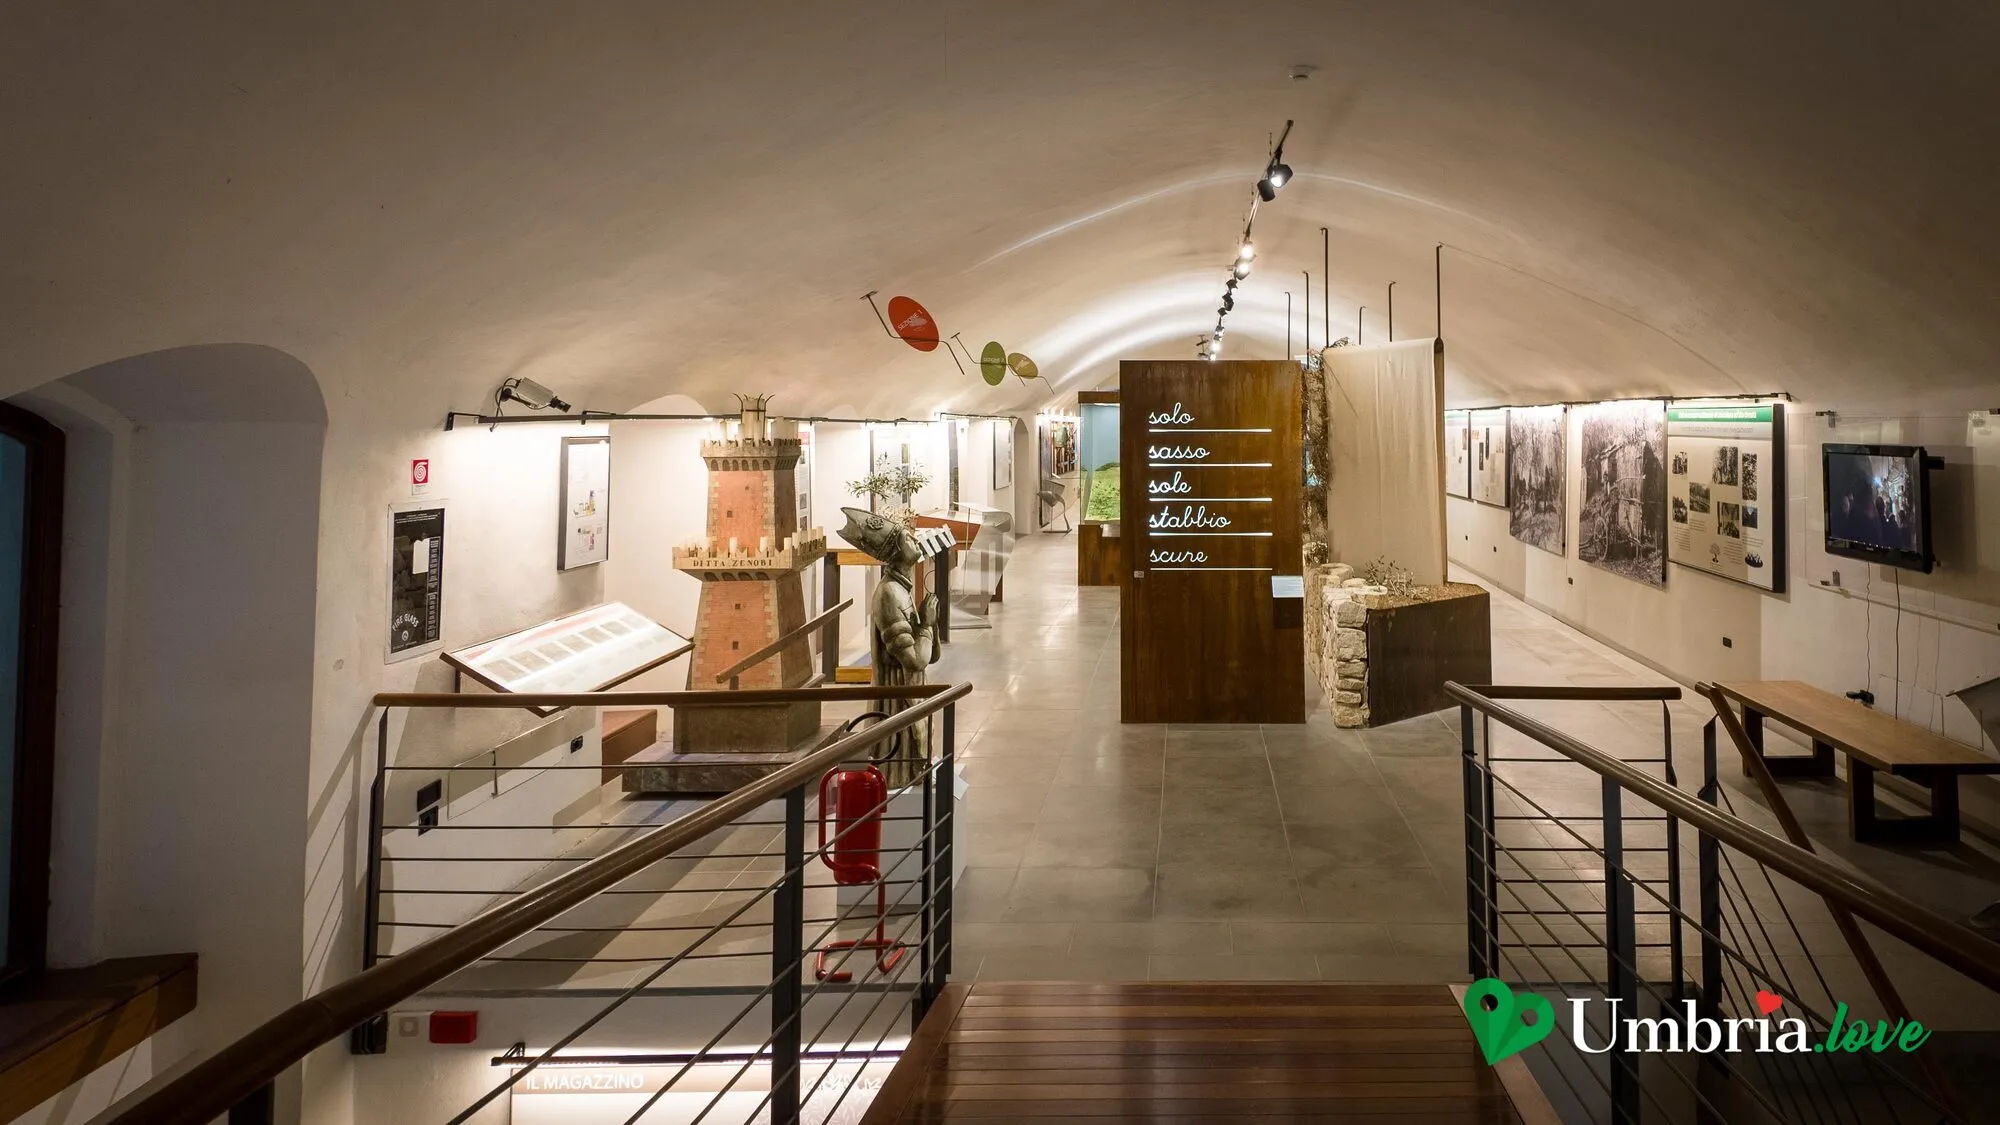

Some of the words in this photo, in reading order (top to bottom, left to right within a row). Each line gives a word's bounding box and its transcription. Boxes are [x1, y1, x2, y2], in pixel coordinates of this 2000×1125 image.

[1149, 402, 1195, 424] solo
[1149, 445, 1211, 459] sasso
[1149, 471, 1192, 494] sole
[1149, 505, 1232, 528] stabbio
[732, 559, 772, 567] ZENOBI
[1150, 549, 1208, 563] scure
[392, 615, 404, 631] FIRE
[403, 613, 420, 628] GLASS
[526, 1075, 540, 1090] IL
[543, 1073, 645, 1090] MAGAZZINO
